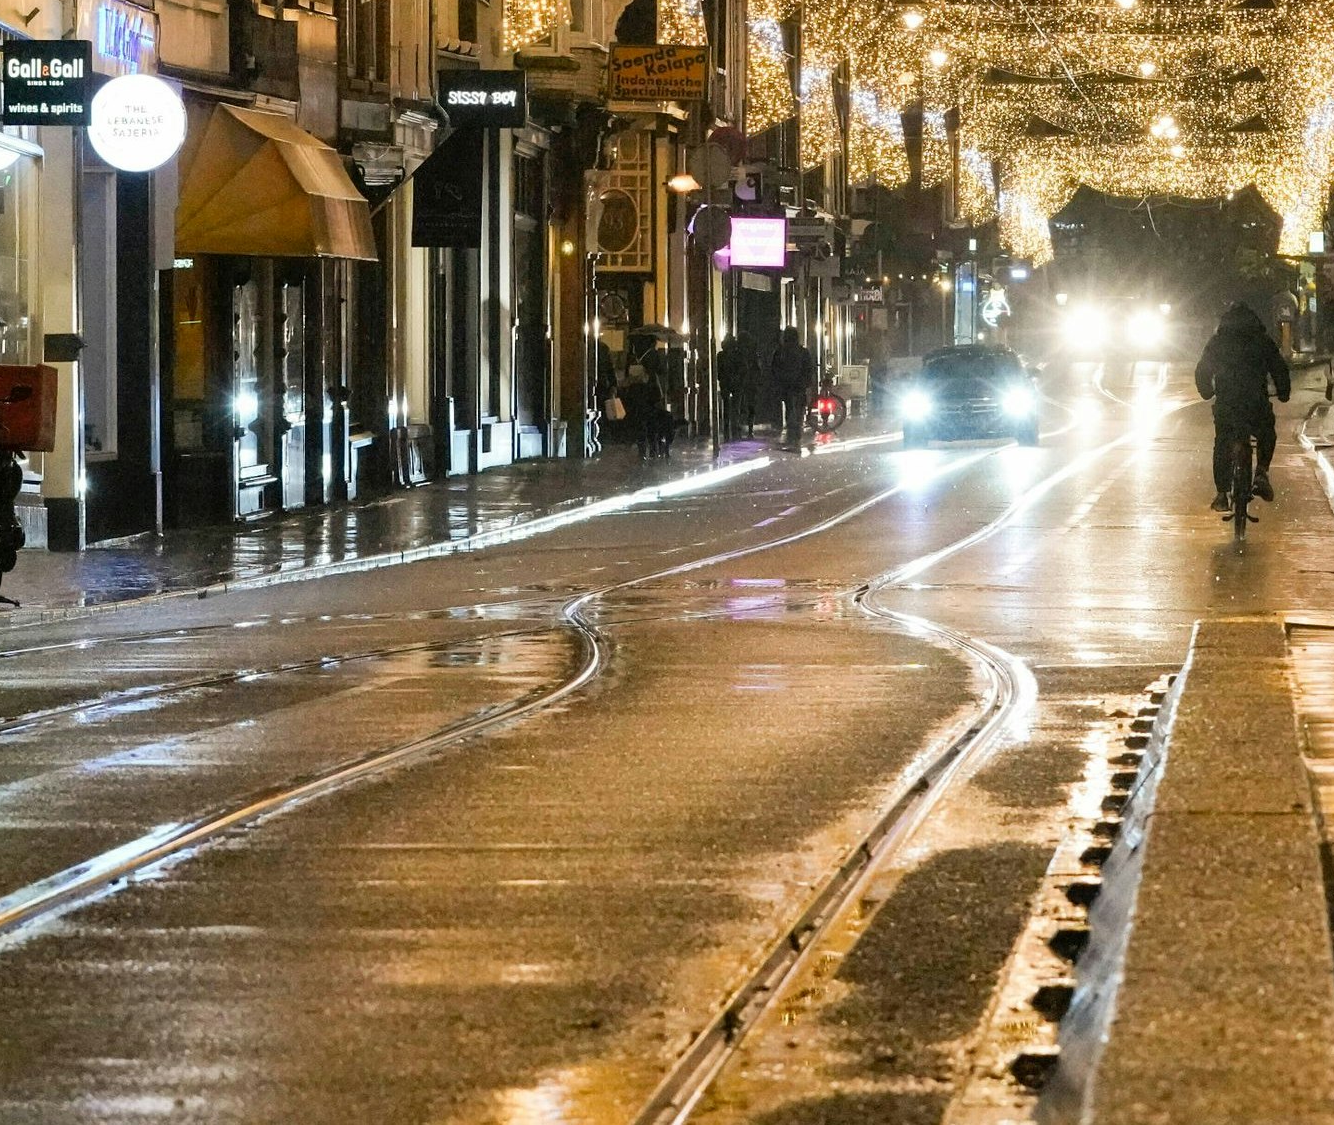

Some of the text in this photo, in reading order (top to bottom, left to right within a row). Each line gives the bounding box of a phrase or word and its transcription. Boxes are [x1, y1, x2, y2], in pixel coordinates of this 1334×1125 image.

[645, 53, 706, 77] Kelapa
[616, 74, 702, 86] Indonesische
[447, 90, 517, 107] SISSY BOY
[8, 103, 83, 116] wines & spirits
[124, 104, 147, 114] THE
[107, 115, 164, 125] LEBANESE
